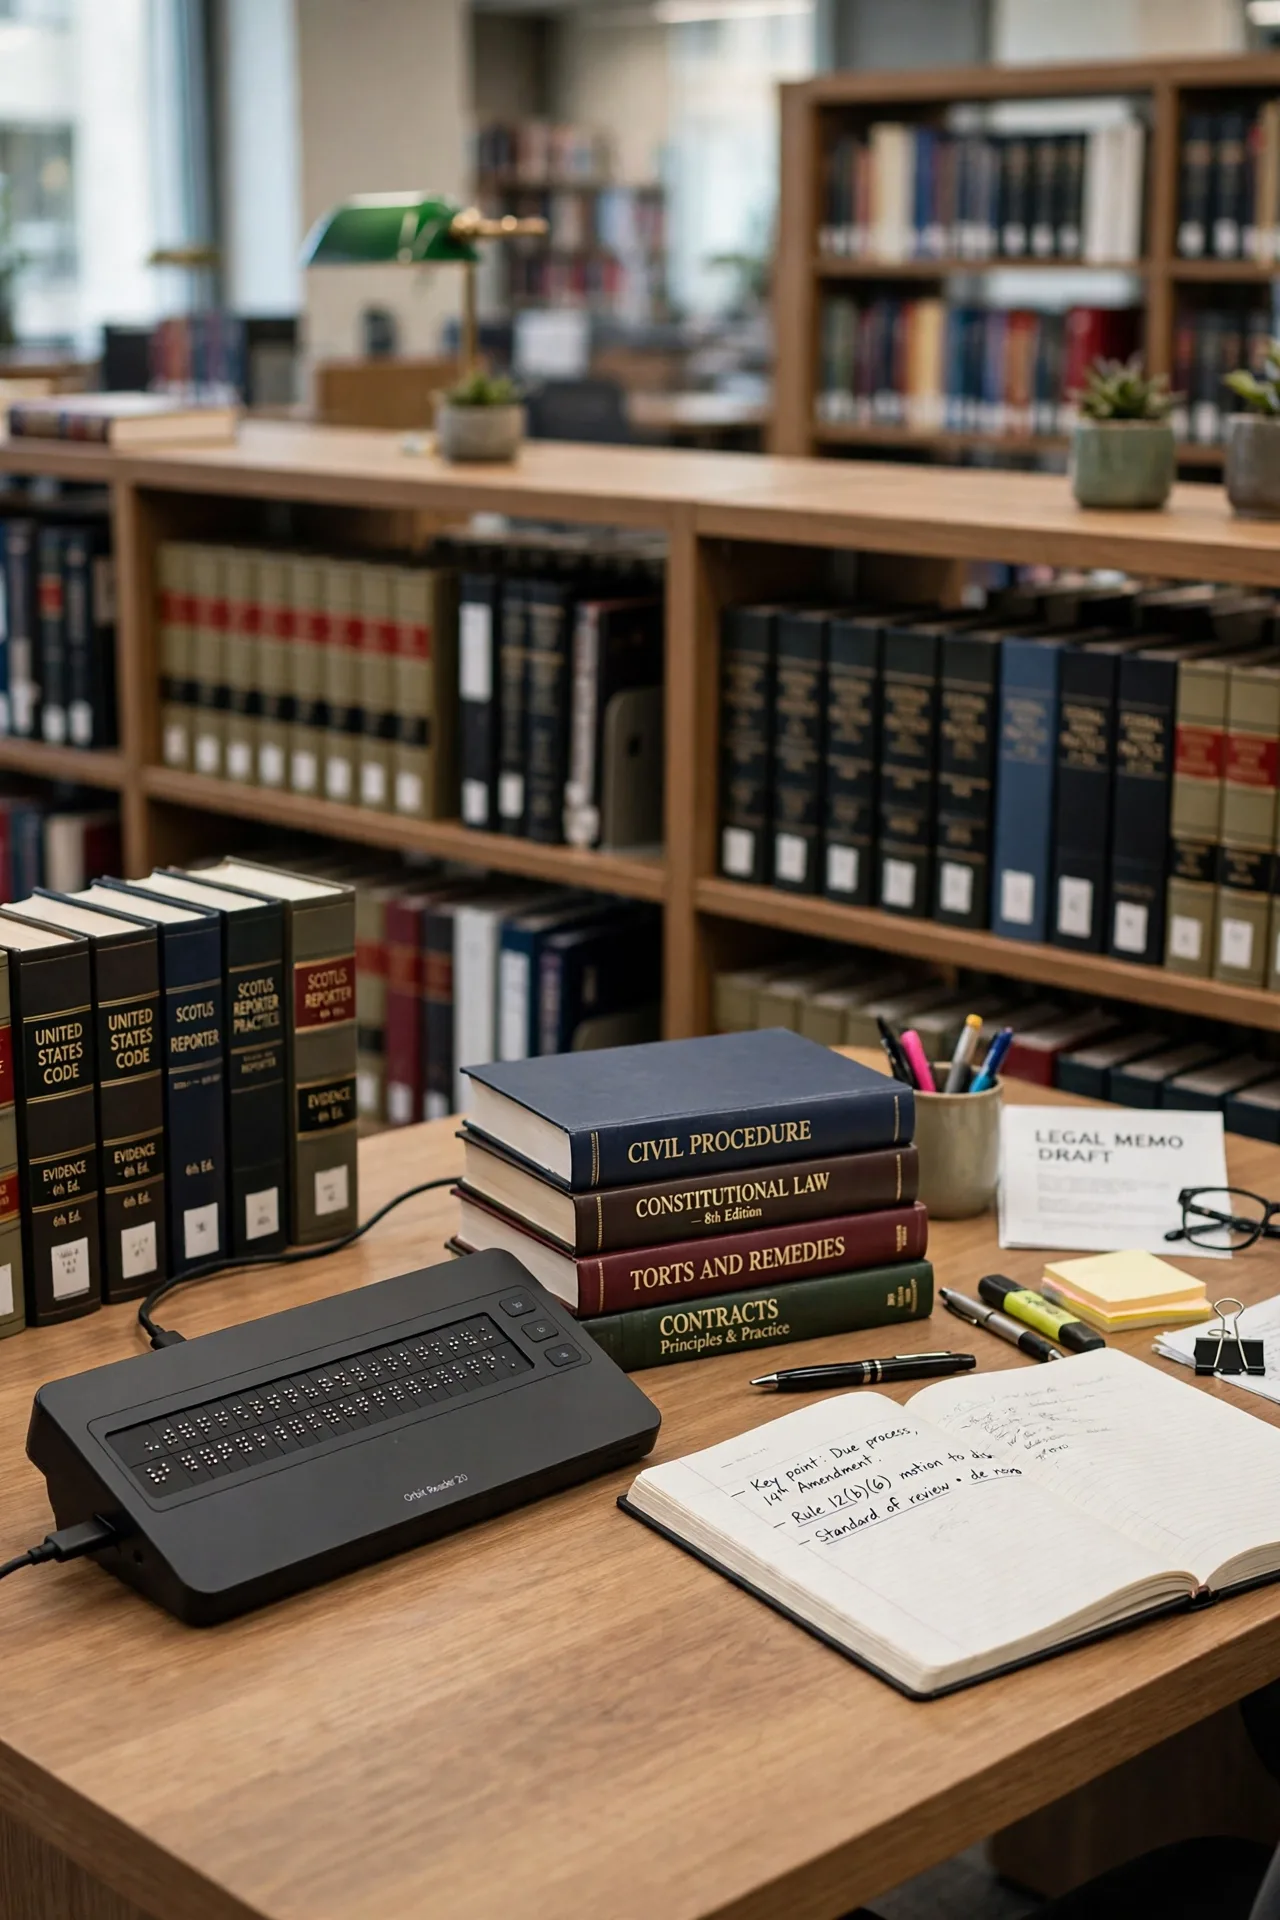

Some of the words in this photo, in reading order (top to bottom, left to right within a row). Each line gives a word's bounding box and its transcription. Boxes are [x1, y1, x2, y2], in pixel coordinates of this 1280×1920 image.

[237, 977, 275, 998] SCOTUS
[308, 968, 348, 990] SCOTUS
[233, 994, 279, 1016] REPORTER
[304, 986, 352, 1008] REPORTER
[108, 1008, 153, 1031] UNITED
[176, 1001, 214, 1023] SCOTUS
[35, 1022, 83, 1046] UNITED
[111, 1027, 153, 1051] STATES
[170, 1028, 220, 1053] REPORTER
[38, 1042, 83, 1067] STATES
[115, 1047, 150, 1069] CODE
[43, 1062, 80, 1085] CODE
[308, 1086, 351, 1109] EVIDENCE
[628, 1138, 684, 1164] CIVIL
[688, 1120, 812, 1156] PROCEDURE
[1035, 1130, 1106, 1146] LEGAL
[1113, 1134, 1184, 1150] MEMO
[114, 1142, 156, 1164] EVIDENCE
[1038, 1148, 1113, 1164] DRAFT
[43, 1160, 87, 1182] EVIDENCE
[635, 1178, 789, 1218] CONSTITUTIONAL
[792, 1172, 830, 1194] LAW
[704, 1211, 721, 1225] 8th
[724, 1206, 763, 1222] Edition
[631, 1261, 695, 1290] TORTS
[700, 1253, 744, 1280] AND
[749, 1236, 846, 1271] REMEDIES
[659, 1298, 779, 1337] CONTRACTS
[660, 1332, 723, 1354] Principles
[725, 1329, 737, 1343] &
[741, 1322, 790, 1342] Practice
[750, 1477, 780, 1492] Key
[829, 1443, 860, 1459] Due
[866, 1426, 919, 1450] process,
[454, 1473, 468, 1484] 20
[791, 1505, 826, 1523] Rule
[827, 1474, 892, 1508] 12(b)(6)
[899, 1460, 944, 1480] motion
[947, 1452, 965, 1462] to
[815, 1508, 880, 1543] Standard
[887, 1496, 900, 1513] of
[908, 1482, 950, 1505] review
[970, 1468, 989, 1480] de
